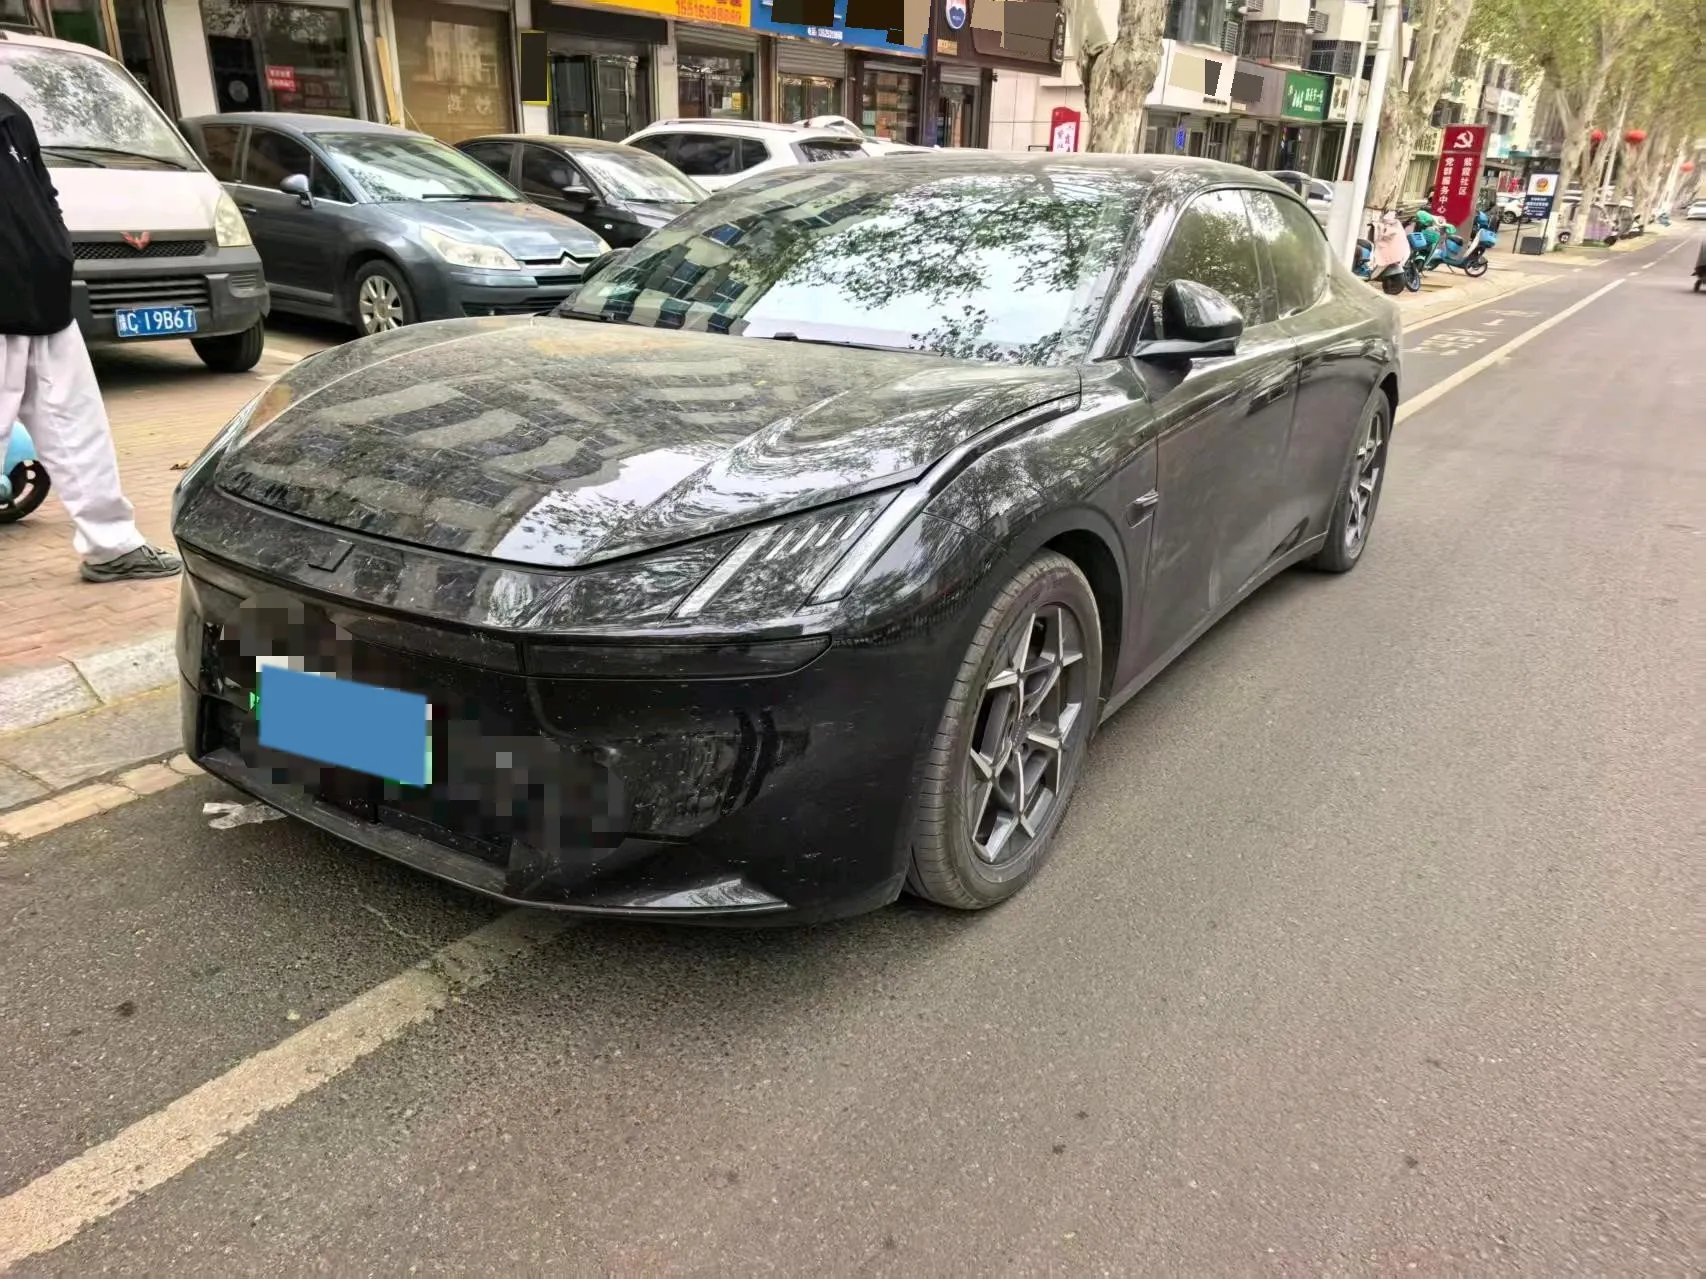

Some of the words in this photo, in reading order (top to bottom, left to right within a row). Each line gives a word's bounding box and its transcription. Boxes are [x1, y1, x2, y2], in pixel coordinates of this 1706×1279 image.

[1436, 157, 1455, 214] 党群服务中心
